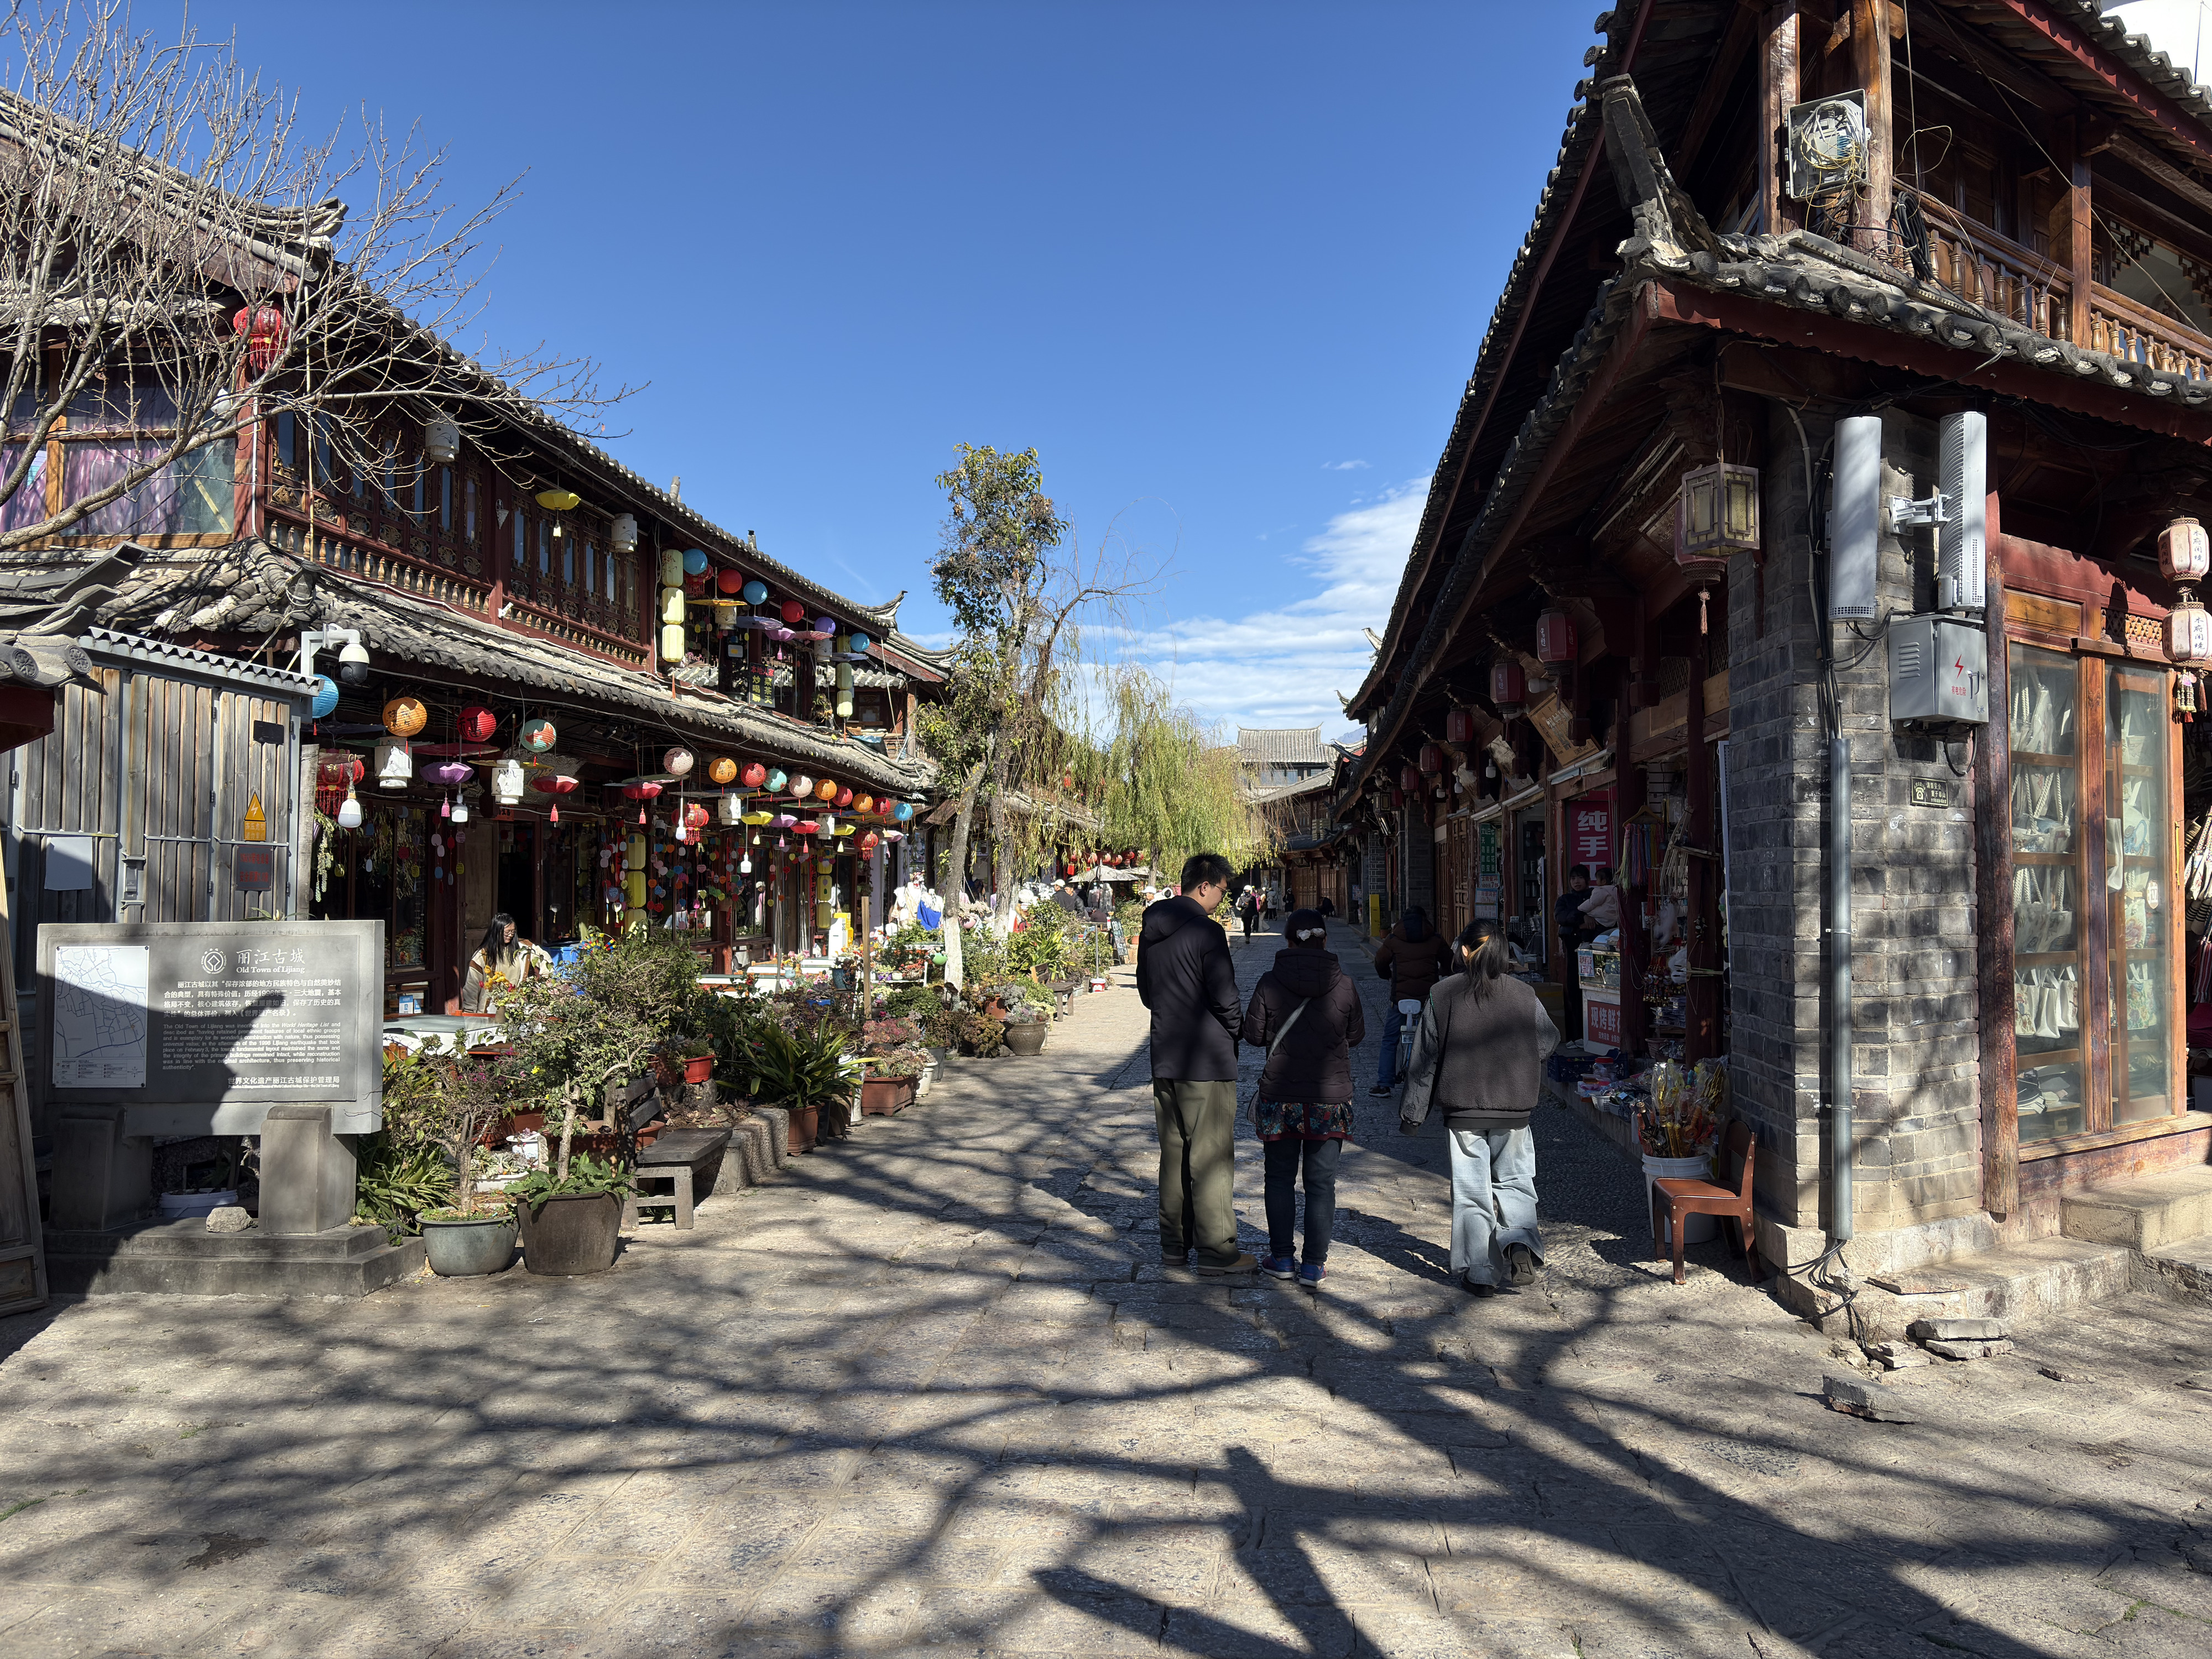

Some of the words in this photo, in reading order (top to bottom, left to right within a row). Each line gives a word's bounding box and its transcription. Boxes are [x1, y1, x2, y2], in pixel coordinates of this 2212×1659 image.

[750, 665, 775, 677] 本地人家
[1951, 686, 1966, 696] 有电危险
[1926, 782, 1942, 790] 消防安全
[1577, 810, 1608, 881] 纯手工
[236, 948, 306, 964] 丽江古城
[228, 1076, 340, 1084] 世界文化遗产丽江古城保护管理局
